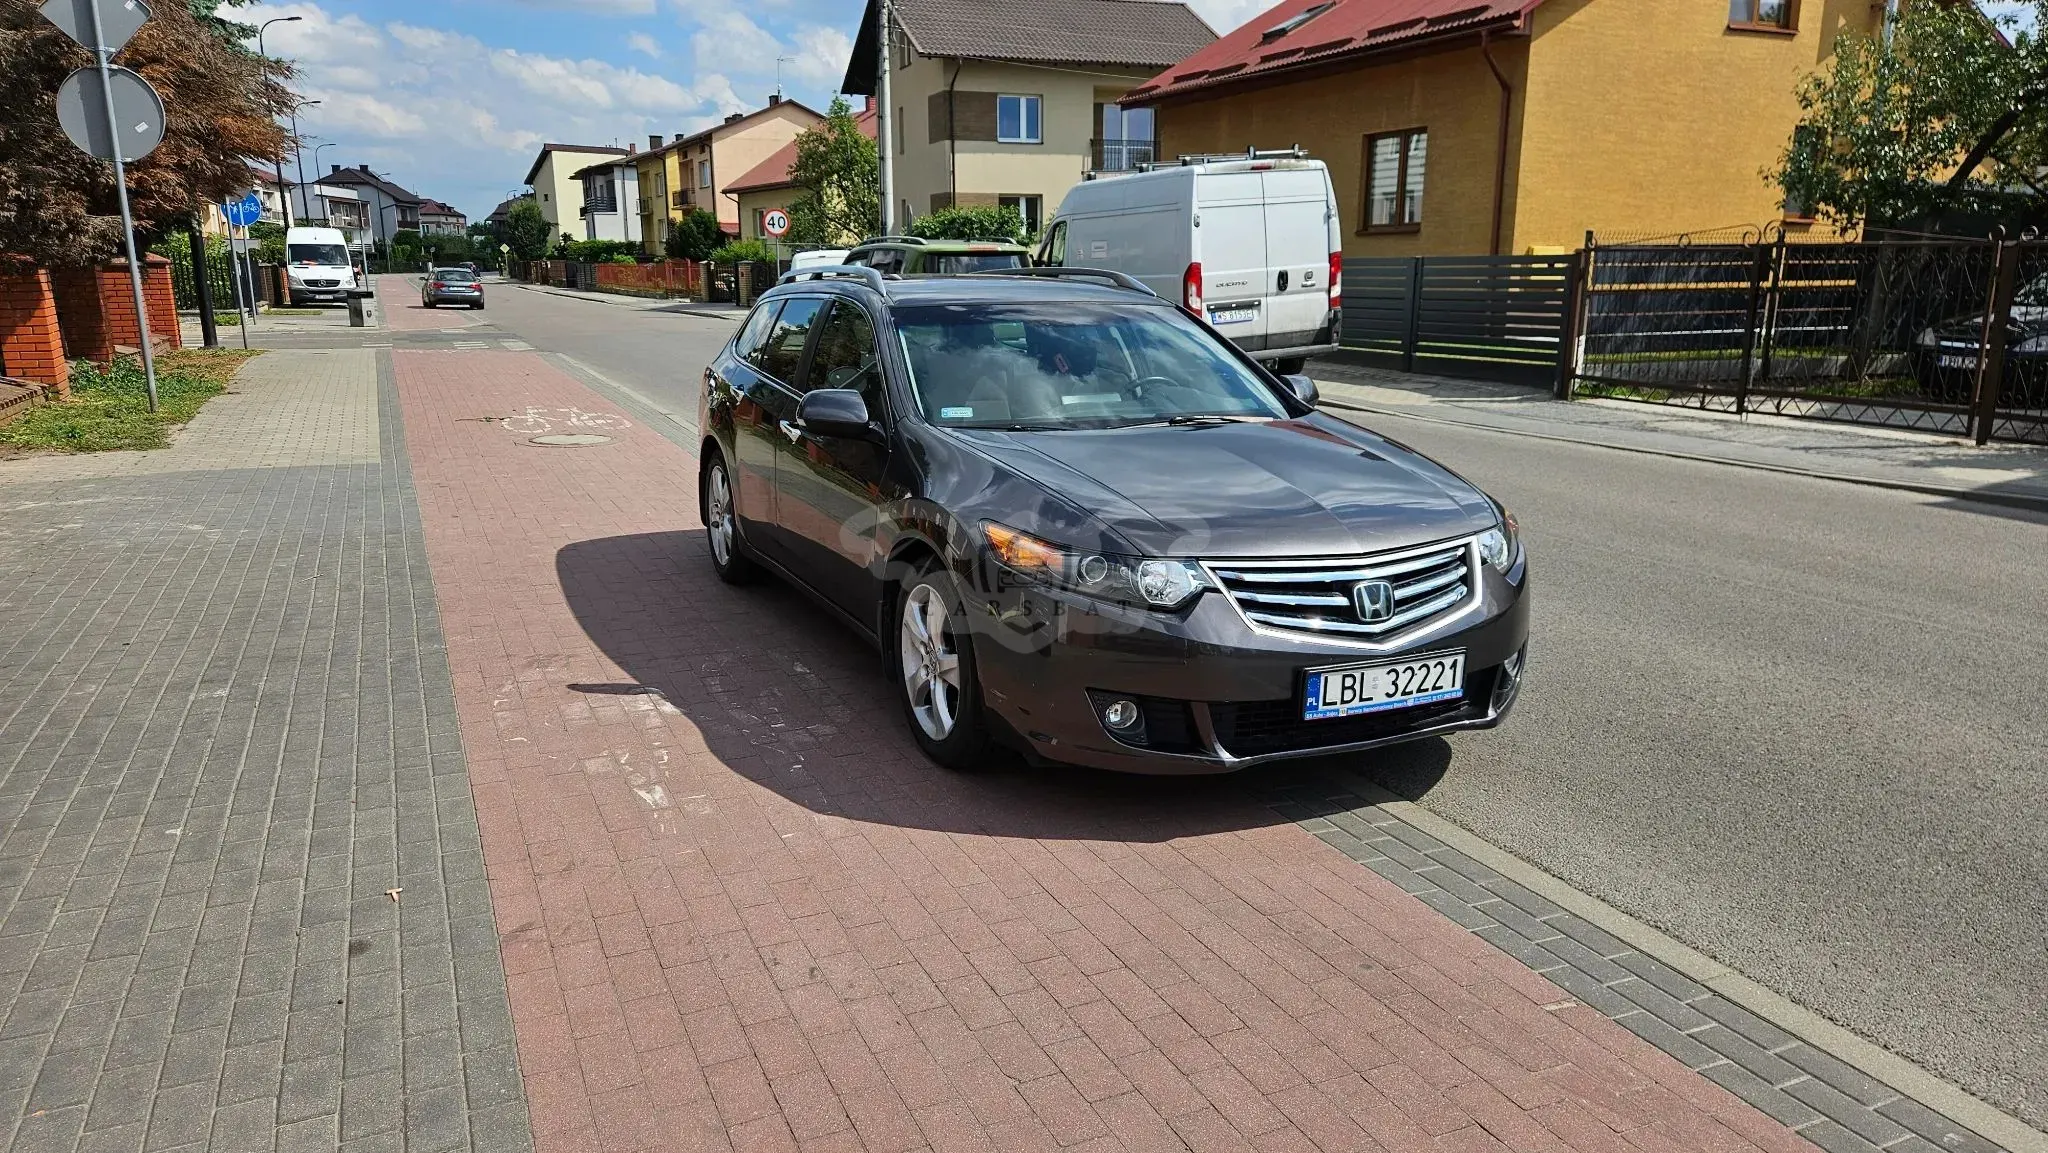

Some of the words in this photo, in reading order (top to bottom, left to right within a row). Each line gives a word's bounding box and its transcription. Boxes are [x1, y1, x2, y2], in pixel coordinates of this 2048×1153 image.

[767, 216, 786, 229] 40
[1322, 671, 1373, 707] LBL
[1385, 658, 1458, 698] 32221
[1306, 697, 1318, 707] PL
